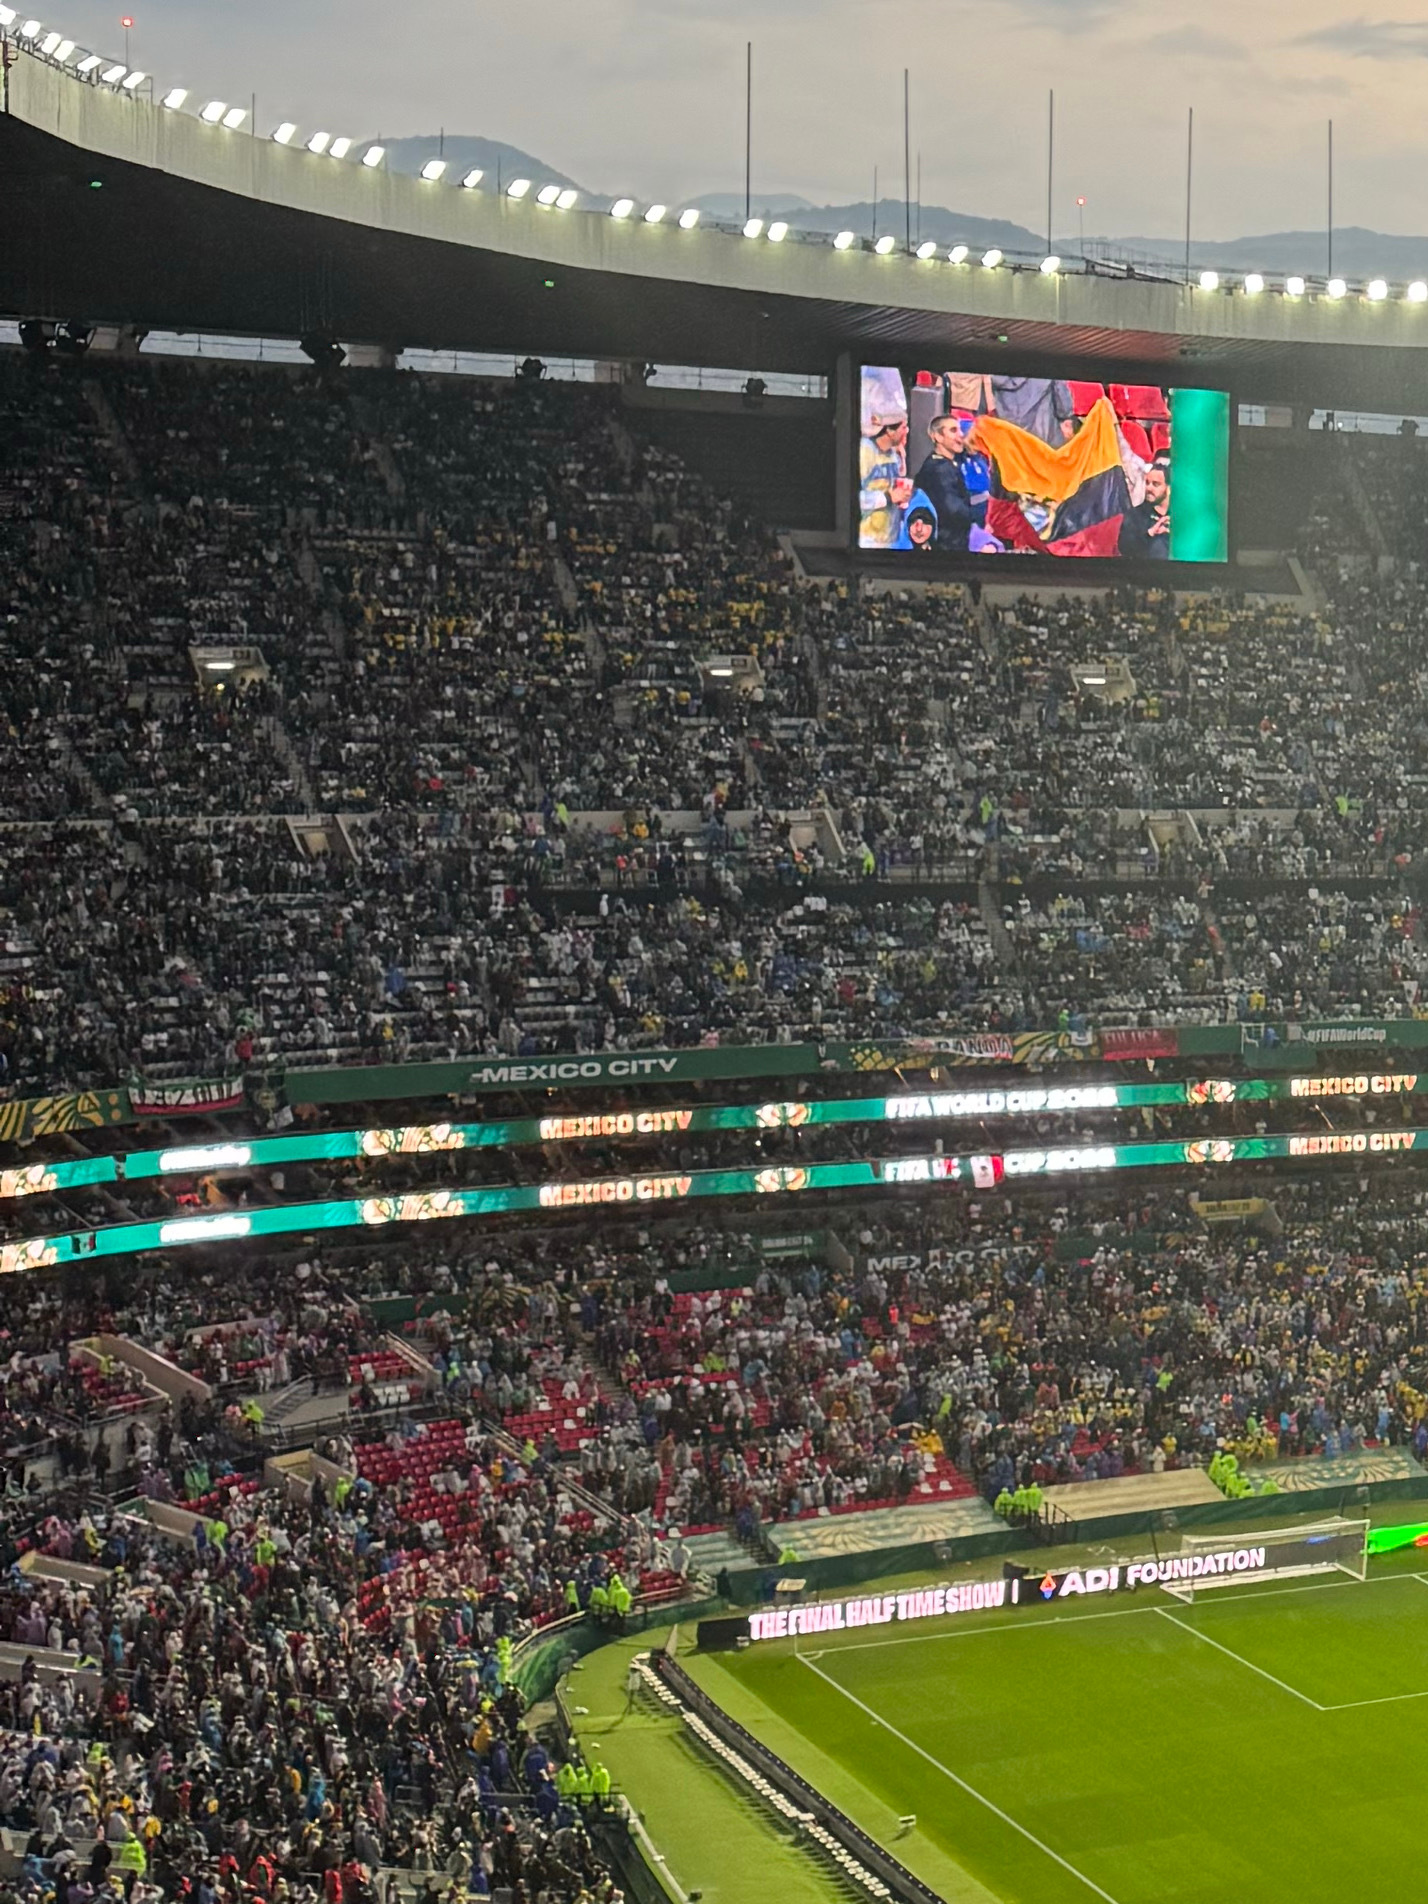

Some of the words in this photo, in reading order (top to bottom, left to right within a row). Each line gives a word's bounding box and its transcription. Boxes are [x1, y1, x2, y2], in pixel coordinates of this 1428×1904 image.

[481, 1061, 602, 1084] MEXICO
[608, 1057, 678, 1076] CITY
[1291, 1077, 1369, 1097] MEXICO
[1371, 1073, 1418, 1093] CITY
[540, 1113, 635, 1140] MEXICO
[636, 1110, 693, 1133] CITY
[1289, 1135, 1368, 1155] MEXICO
[1369, 1132, 1416, 1152] CITY
[539, 1180, 635, 1207] MEXICO
[636, 1176, 693, 1200] CITY
[748, 1611, 788, 1641] THE
[788, 1603, 845, 1636] FINAL
[946, 1581, 1006, 1614] SHOW
[1058, 1566, 1119, 1597] ADI
[1126, 1547, 1266, 1586] FOUNDATION
